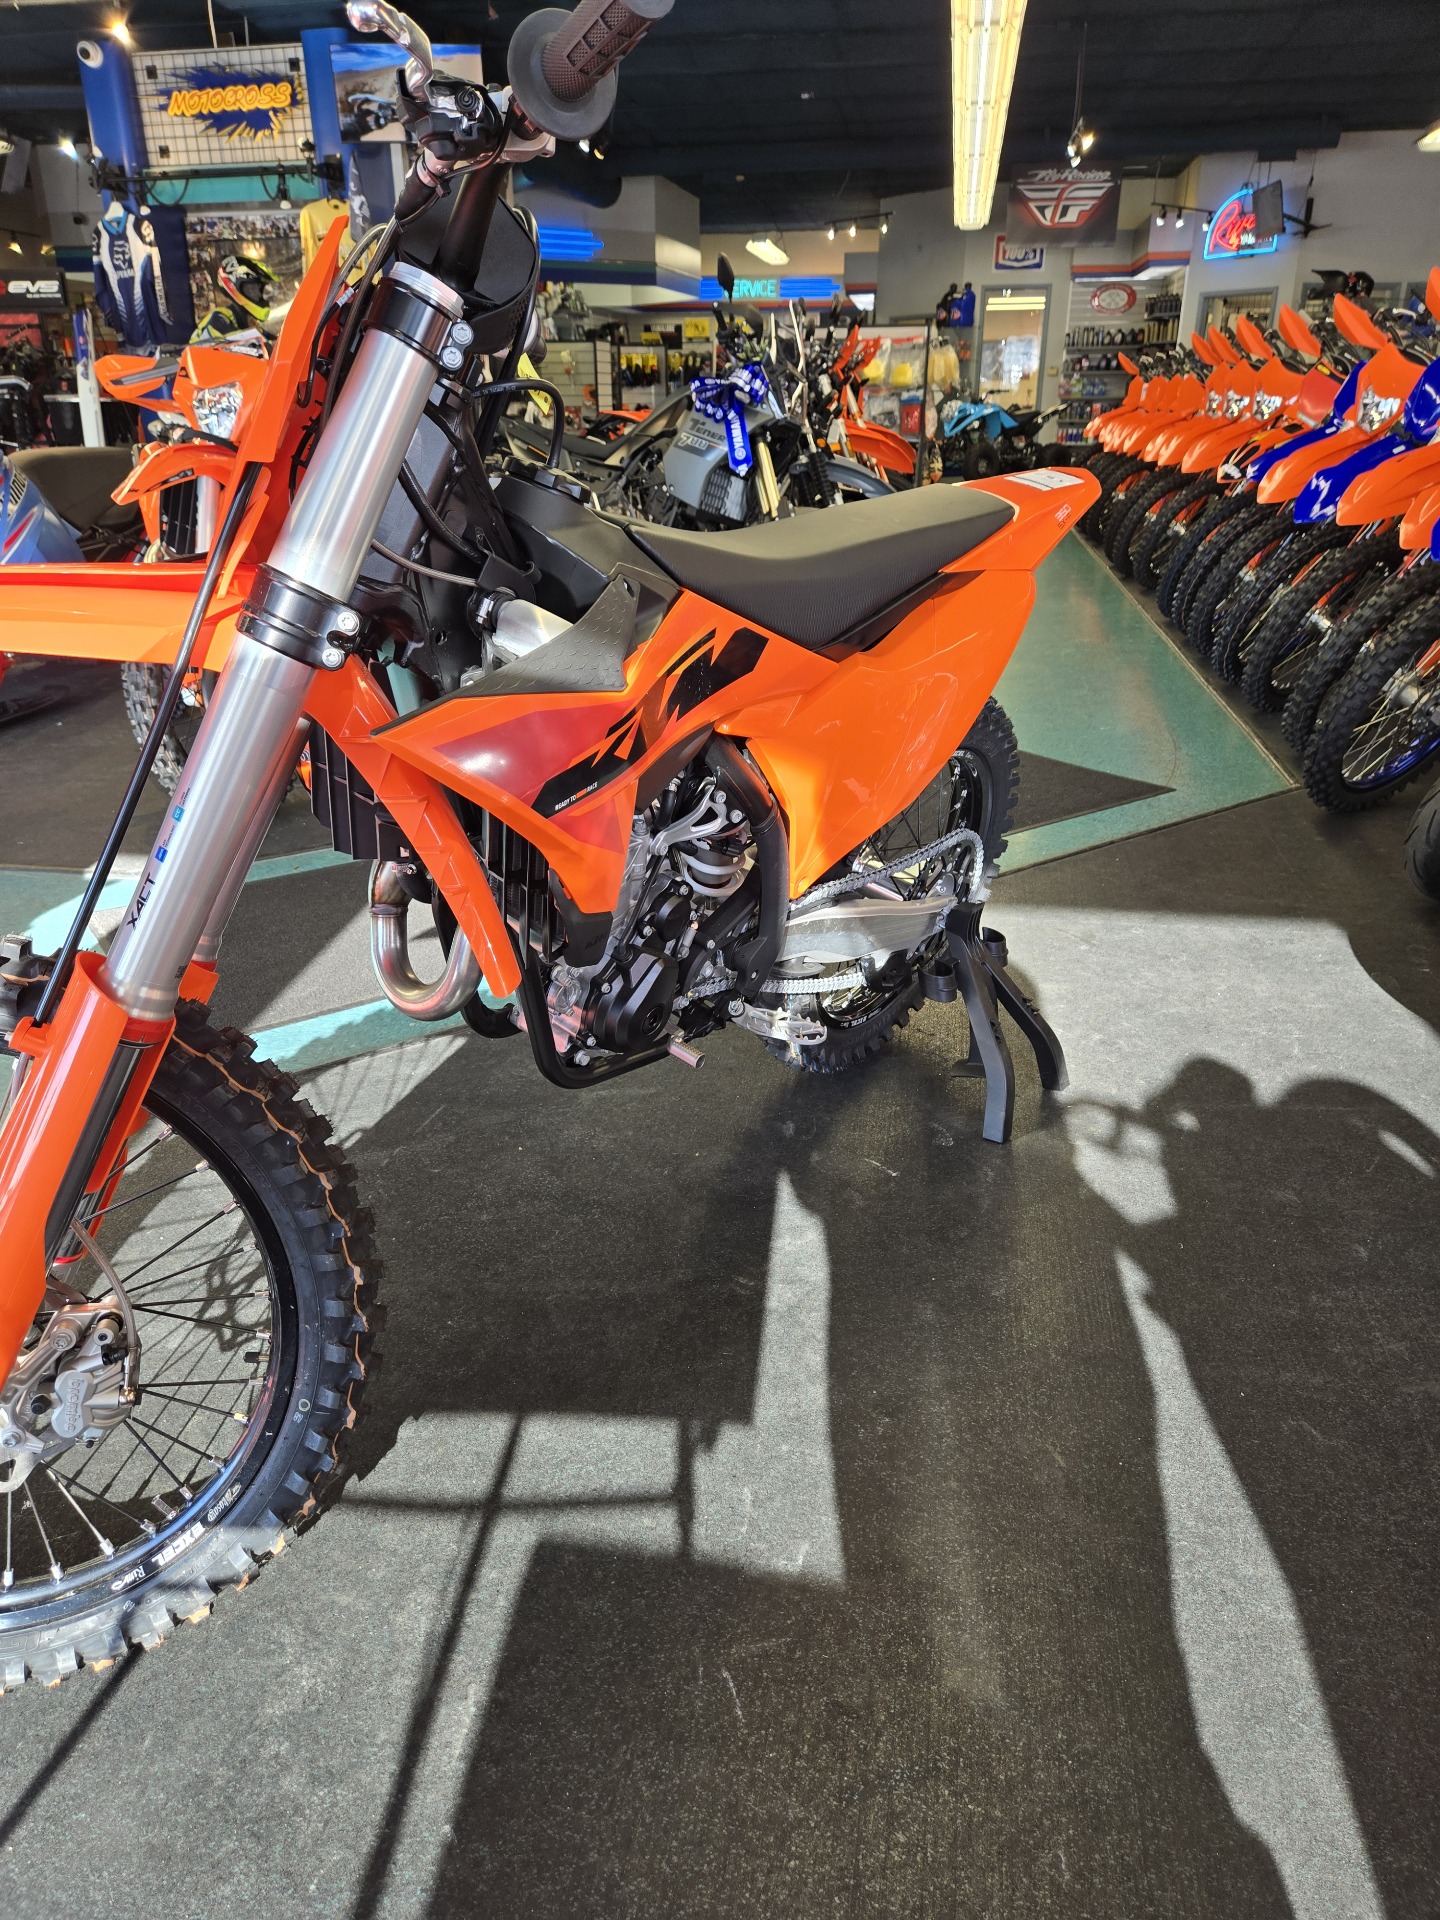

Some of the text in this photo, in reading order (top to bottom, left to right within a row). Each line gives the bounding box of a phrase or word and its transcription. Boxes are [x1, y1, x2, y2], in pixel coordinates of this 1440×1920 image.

[168, 82, 292, 117] MOTOCROSS
[723, 279, 777, 298] ERVICE
[555, 799, 570, 811] READY
[586, 782, 598, 792] RACE
[126, 872, 156, 930] XACT
[66, 1378, 85, 1431] brembo
[151, 1521, 206, 1567] EXCEL
